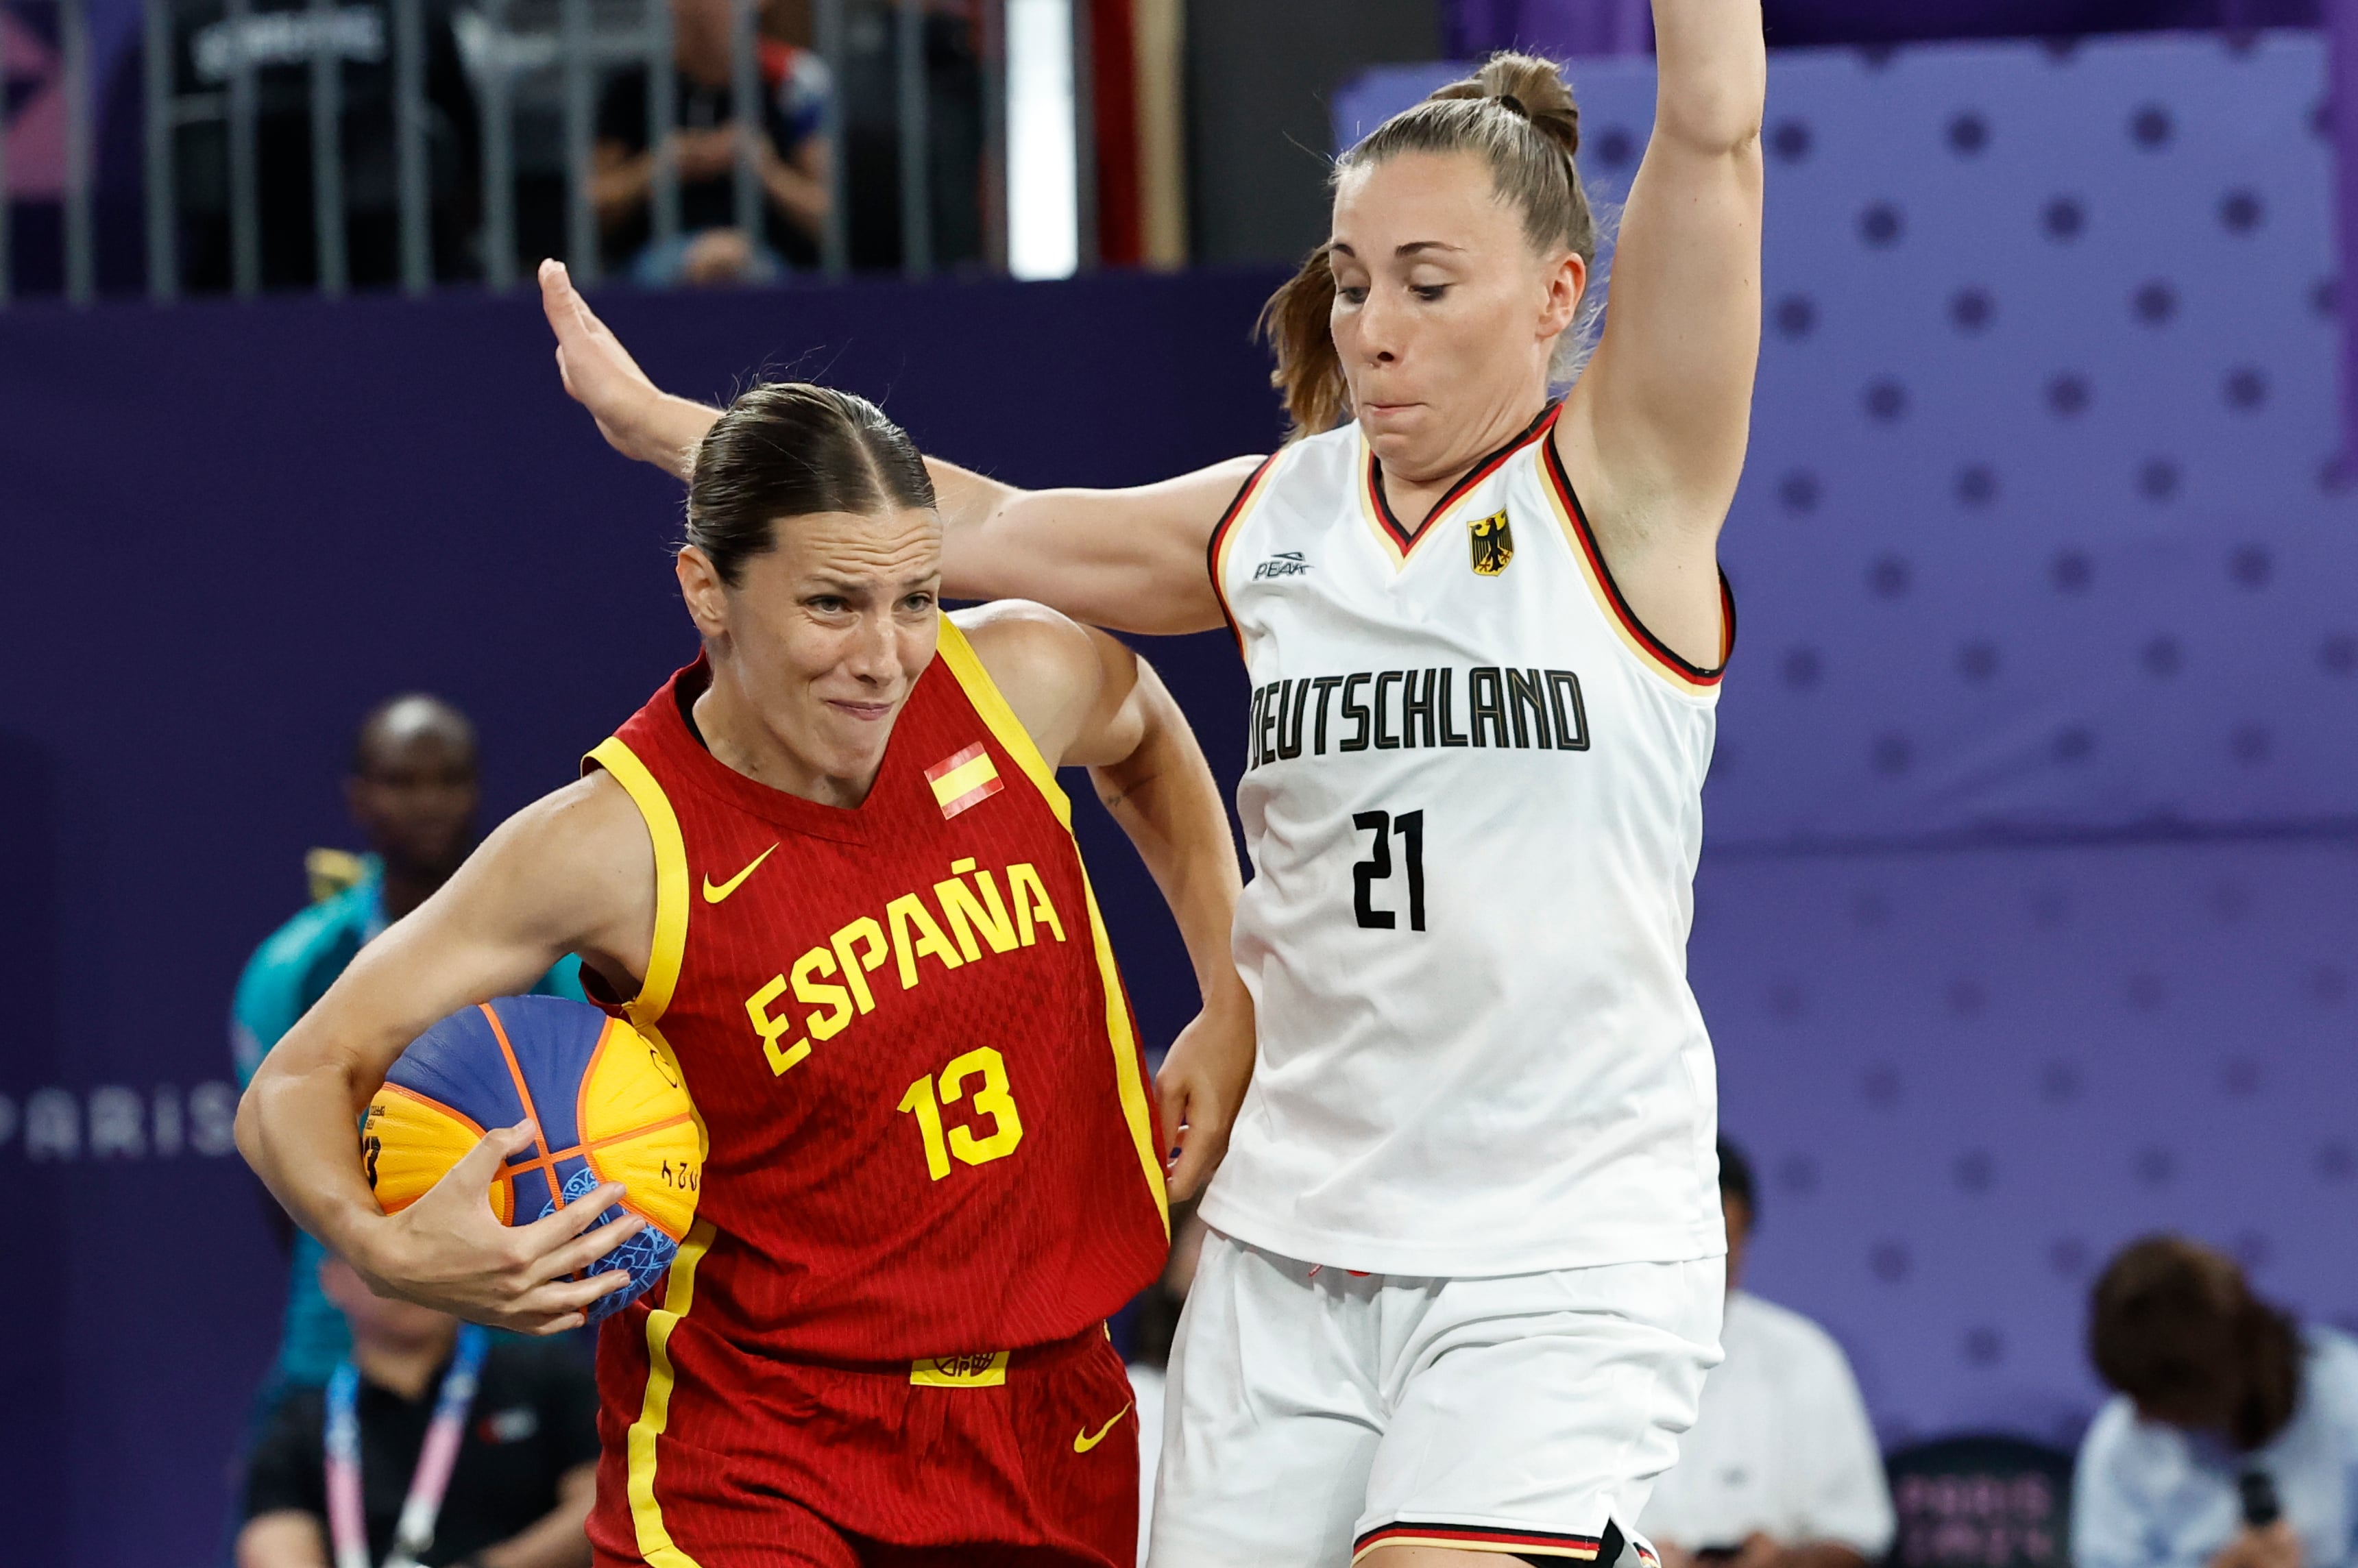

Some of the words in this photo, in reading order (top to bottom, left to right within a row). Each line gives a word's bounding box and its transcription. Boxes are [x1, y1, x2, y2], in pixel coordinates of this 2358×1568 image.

[1252, 561, 1315, 581] PEAK
[1251, 667, 1590, 771] DEUTSCHLAND
[1352, 809, 1426, 932] 21
[745, 857, 1066, 1077] ESPAÑA
[897, 1046, 1023, 1181] 13
